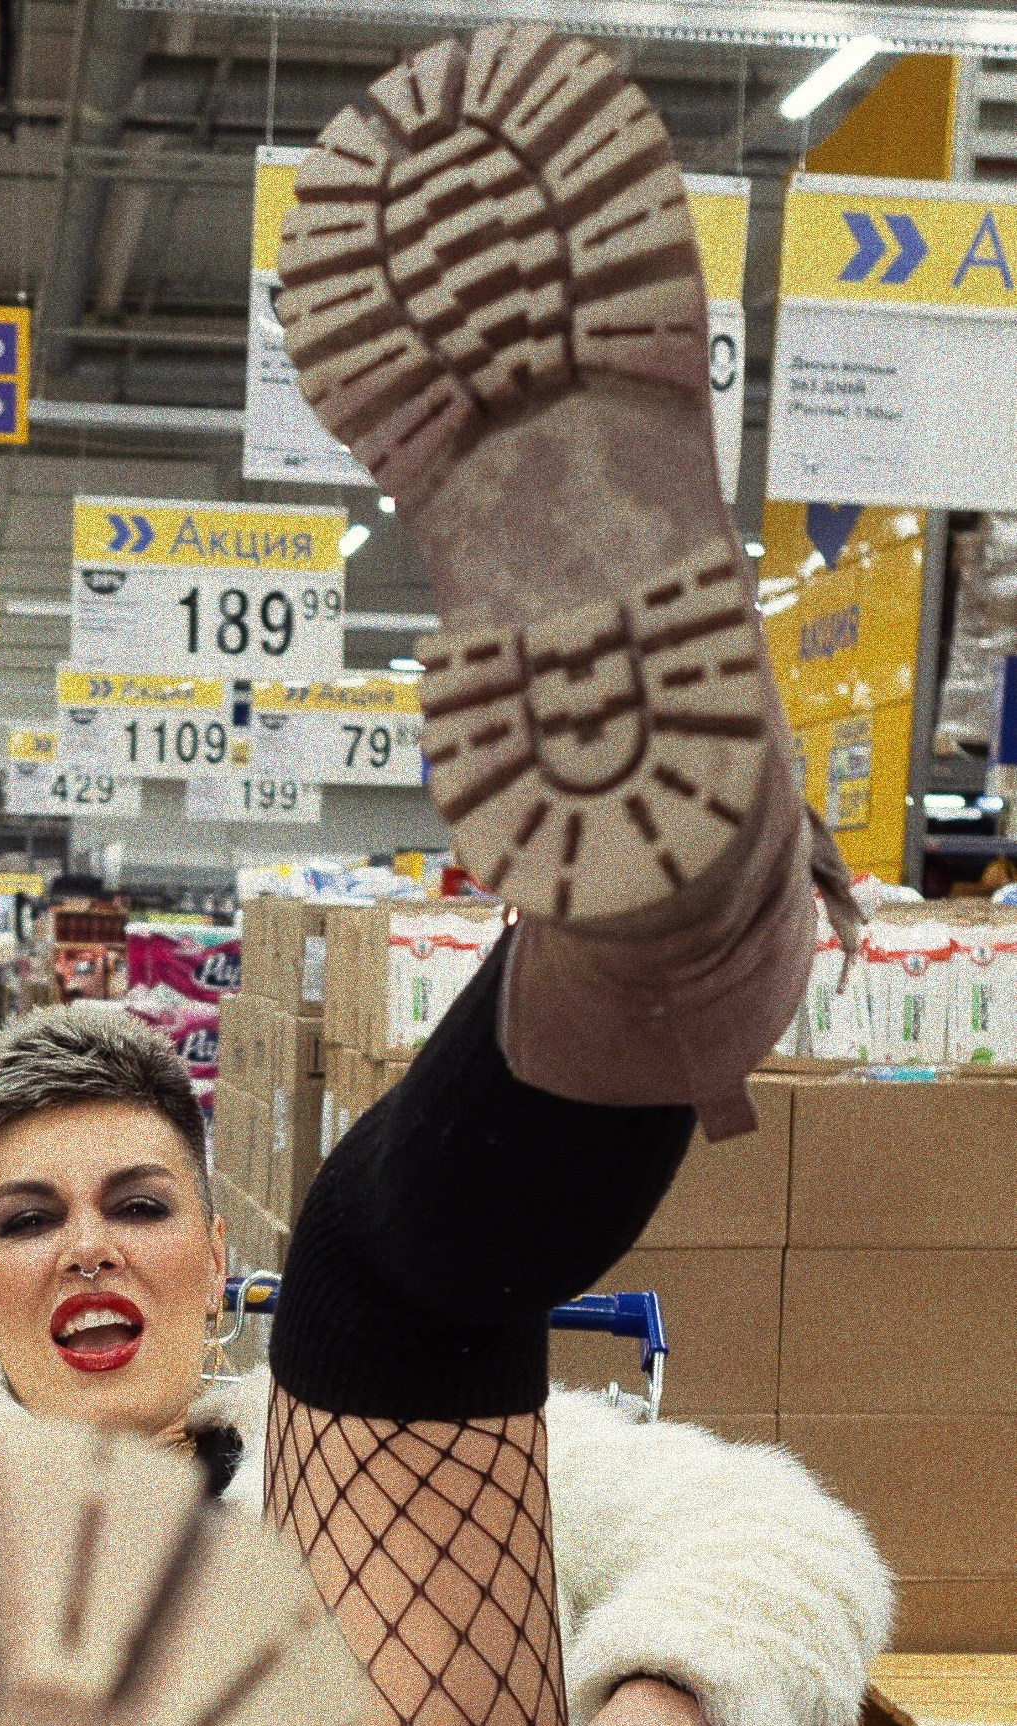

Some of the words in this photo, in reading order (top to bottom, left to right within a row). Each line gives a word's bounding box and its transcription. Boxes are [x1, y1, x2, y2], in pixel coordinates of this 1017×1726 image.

[169, 515, 313, 564] Акция
[179, 586, 295, 657] 189
[301, 587, 342, 621] 99
[124, 720, 228, 765] 1109
[341, 724, 392, 769] 79
[50, 774, 116, 804] 429
[242, 779, 297, 811] 199
